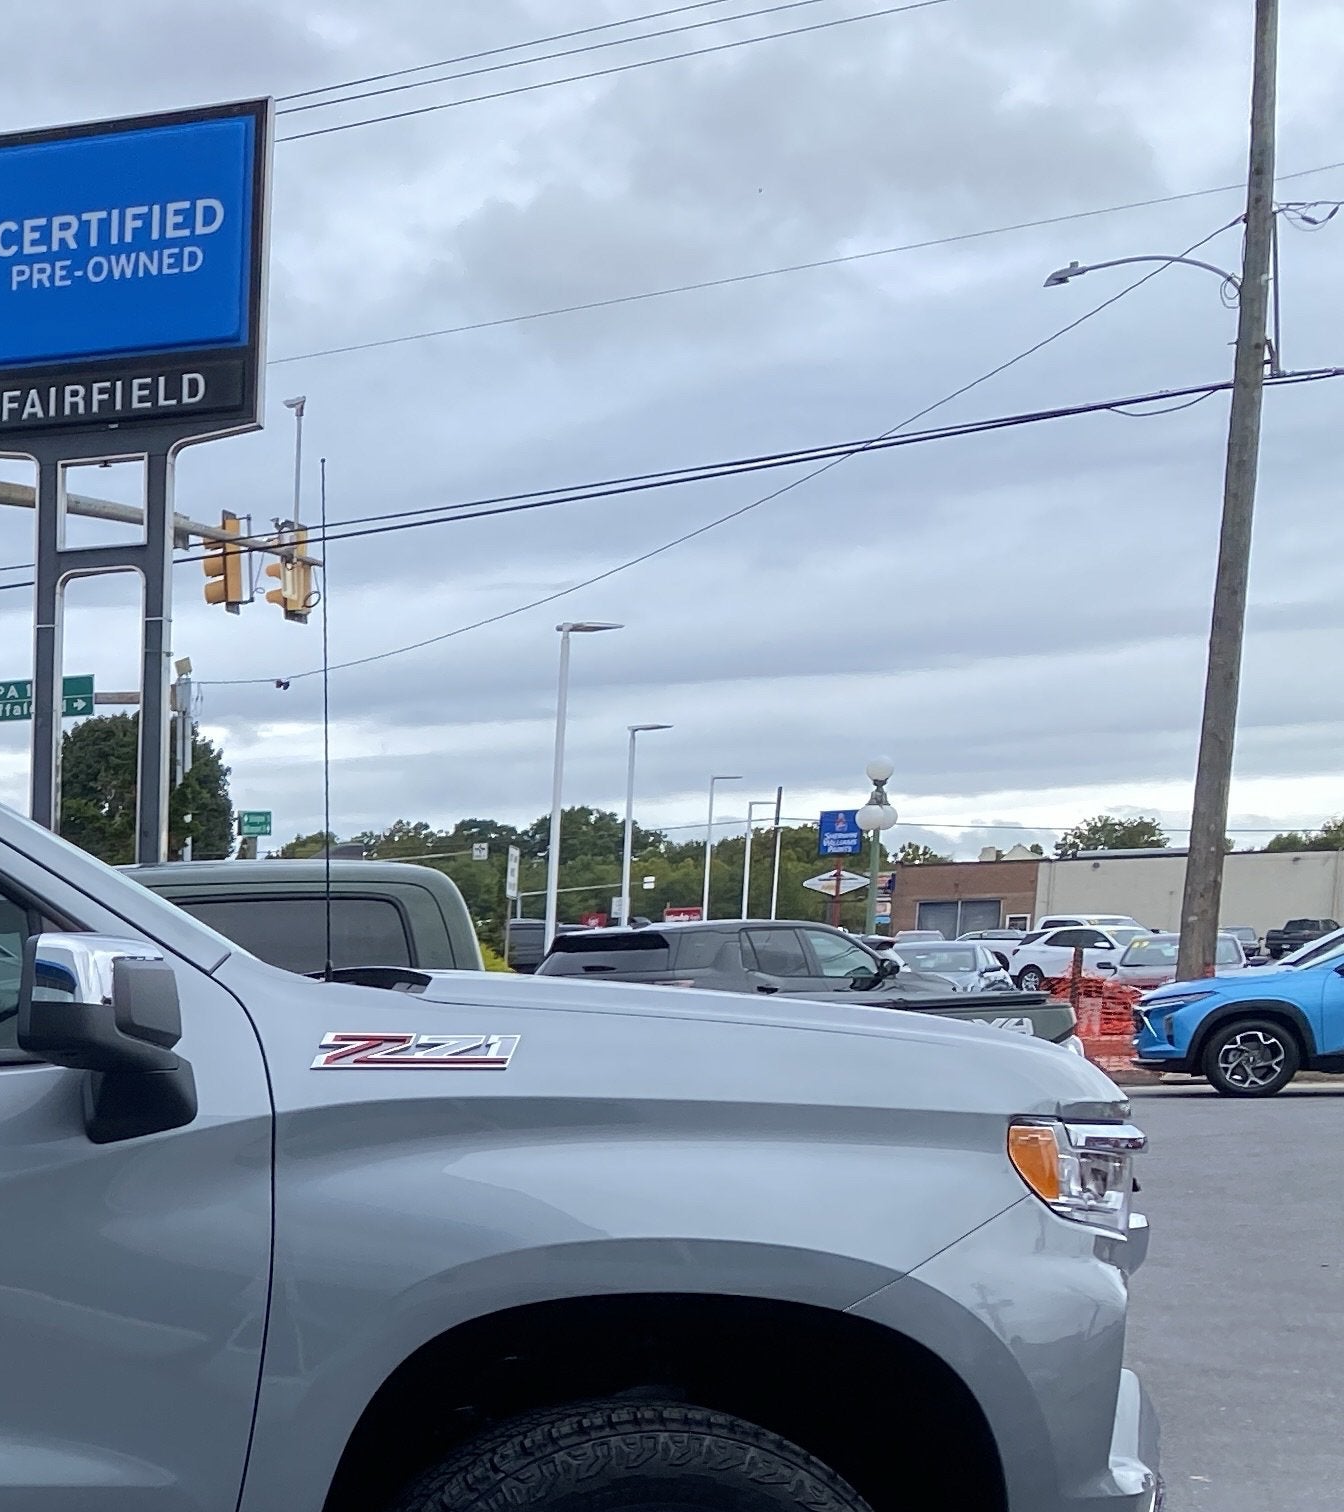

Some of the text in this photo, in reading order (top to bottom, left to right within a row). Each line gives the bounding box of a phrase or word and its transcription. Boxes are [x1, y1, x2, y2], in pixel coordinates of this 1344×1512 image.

[11, 246, 204, 291] PRE-OWNED
[1, 372, 206, 422] FAIRFIELD
[310, 1031, 522, 1070] Z71
